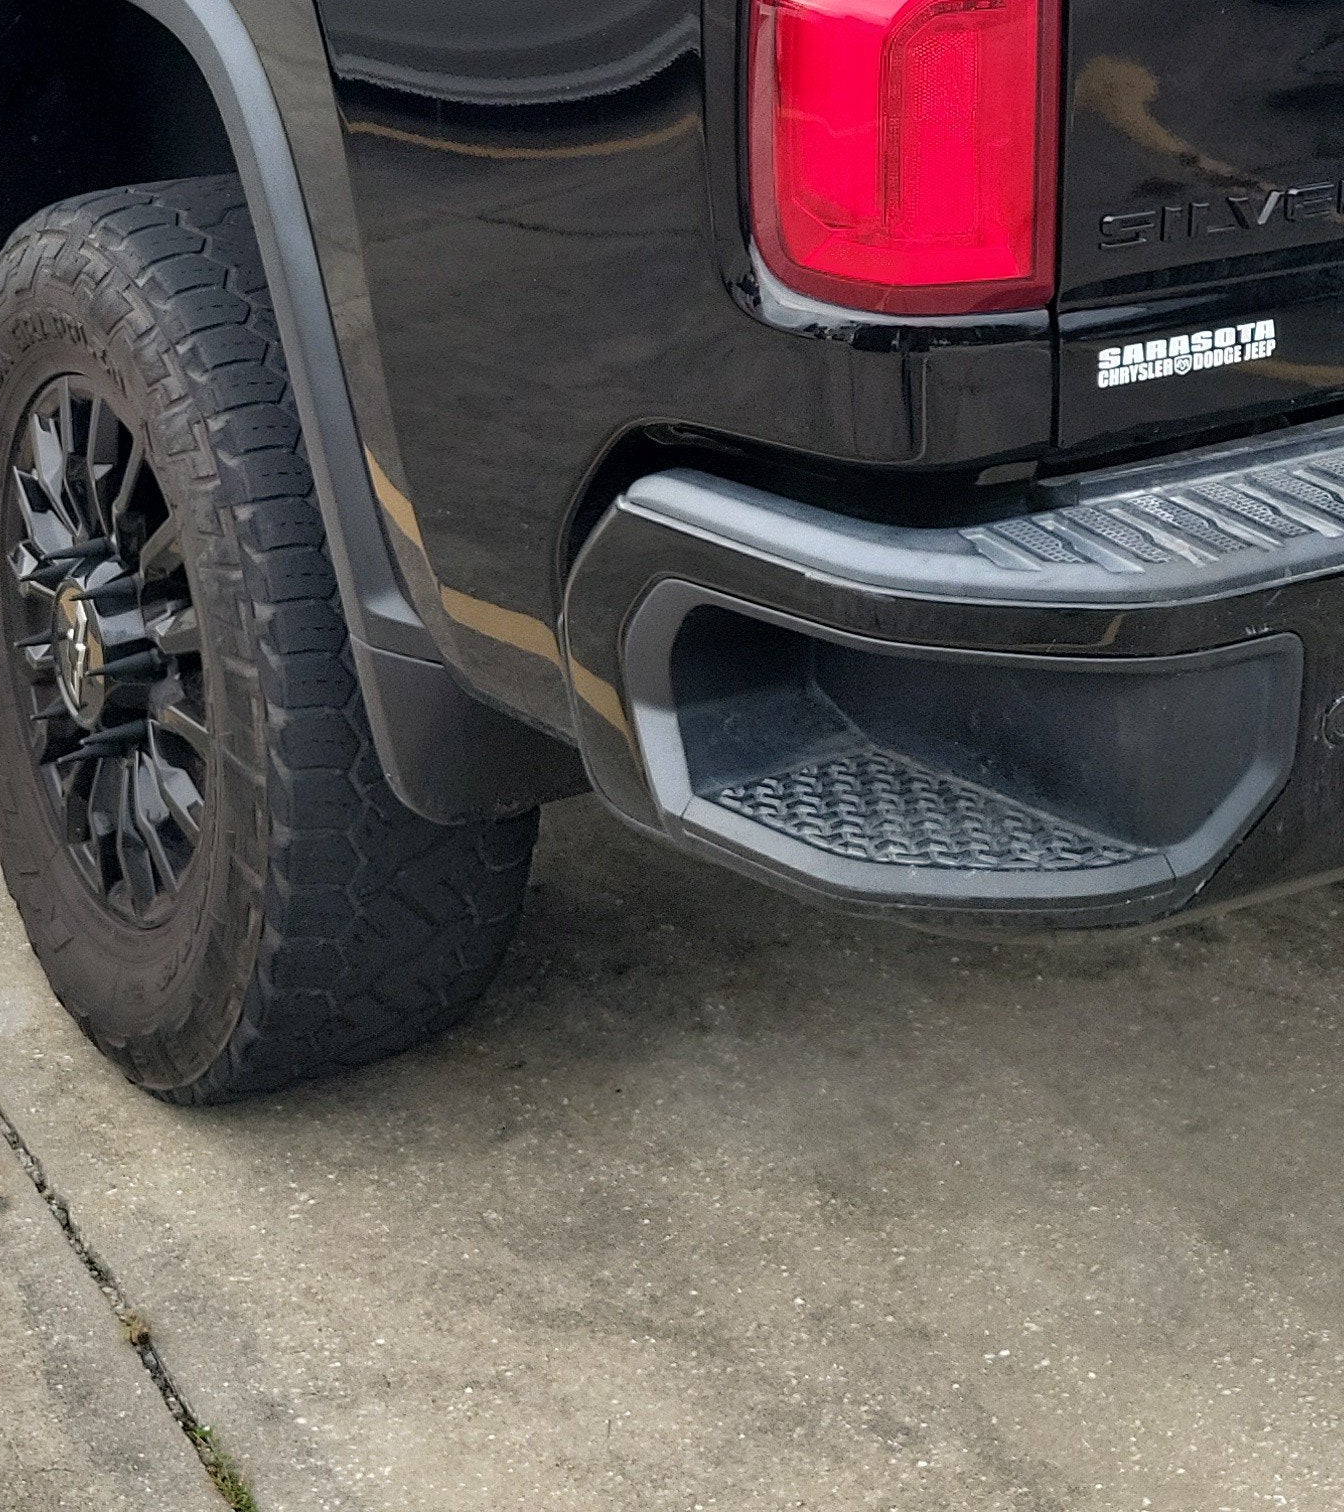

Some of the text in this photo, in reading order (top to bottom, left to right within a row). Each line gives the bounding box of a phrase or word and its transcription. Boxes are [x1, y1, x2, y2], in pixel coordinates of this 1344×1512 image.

[1097, 338, 1277, 389] CHRYSLER DODGE JEEP
[1098, 319, 1276, 370] SARASOTA
